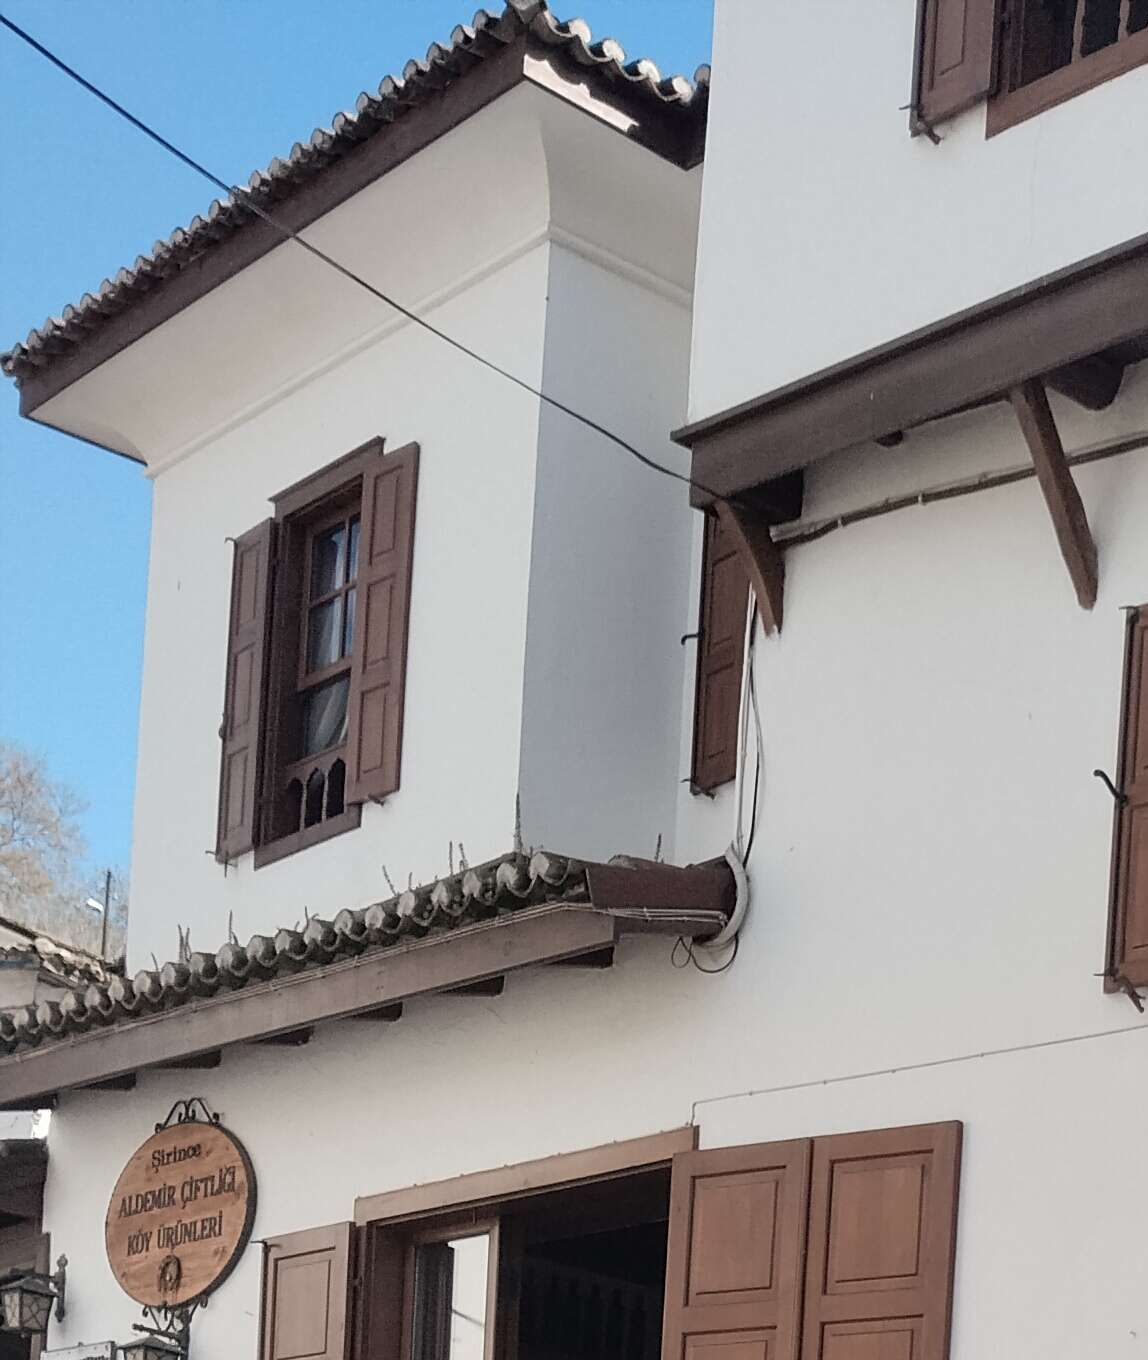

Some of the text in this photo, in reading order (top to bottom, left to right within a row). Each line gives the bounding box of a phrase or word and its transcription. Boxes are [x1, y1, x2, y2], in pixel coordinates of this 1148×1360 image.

[151, 1142, 202, 1174] Şirince
[118, 1166, 237, 1219] ALDEMİR ÇİFTLİĞİ
[126, 1211, 223, 1257] KÖY ÜRÜNLERİ
